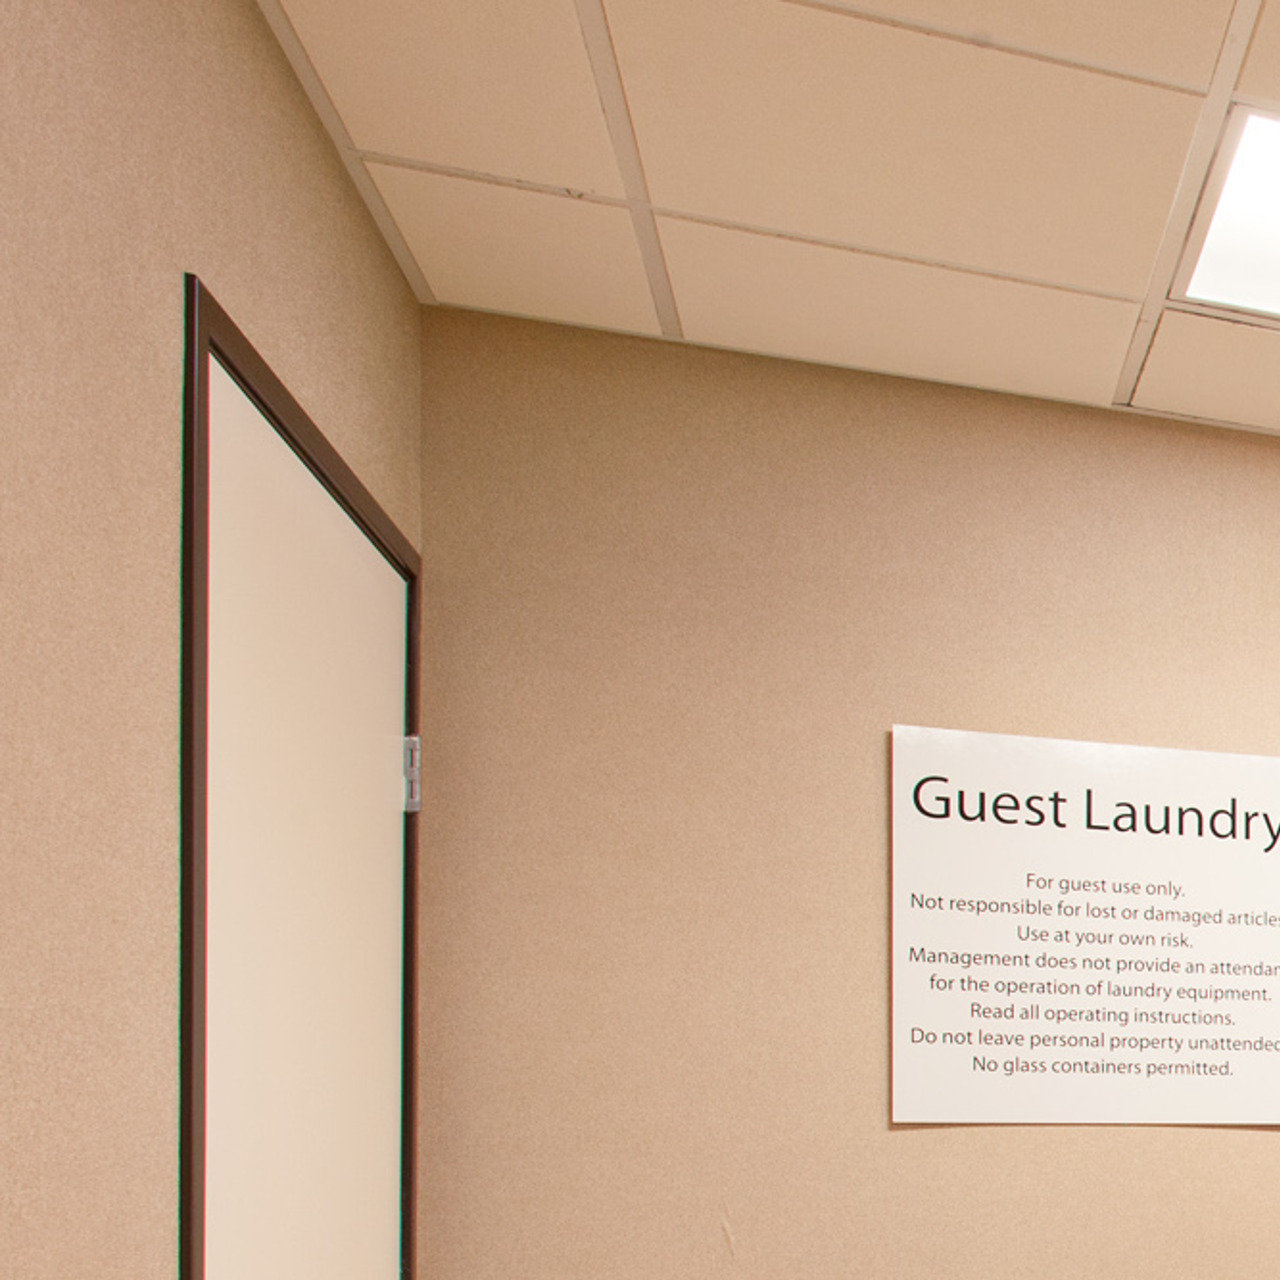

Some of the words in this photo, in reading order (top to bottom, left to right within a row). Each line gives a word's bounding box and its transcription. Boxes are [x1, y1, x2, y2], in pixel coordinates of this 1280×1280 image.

[912, 775, 1068, 828] Guest
[1026, 873, 1054, 890] For
[1059, 878, 1106, 894] guest
[1112, 880, 1140, 893] use
[1145, 880, 1185, 899] only.
[910, 893, 944, 911] Not
[949, 896, 1053, 918] responsible
[1058, 901, 1081, 917] for
[1086, 901, 1116, 919] lost
[1121, 906, 1139, 920] or
[1144, 906, 1222, 926] damaged
[1017, 926, 1049, 942] Use
[1053, 930, 1070, 943] at
[1075, 931, 1114, 949] your
[1119, 933, 1156, 946] own
[1160, 931, 1193, 948] risk.
[908, 947, 1030, 969] Management
[1035, 952, 1078, 969] does
[1083, 956, 1111, 970] not
[1116, 954, 1180, 975] provide
[1185, 959, 1205, 974] an
[930, 974, 954, 991] for
[960, 975, 989, 992] the
[994, 977, 1081, 998] operation
[1085, 980, 1104, 996] of
[1107, 981, 1172, 1001] laundry
[1176, 985, 1272, 1003] equipment.
[970, 1002, 1014, 1020] Read
[1019, 1003, 1040, 1021] all
[1044, 1005, 1129, 1026] operating
[1134, 1008, 1235, 1026] instructions.
[911, 1027, 938, 1044] Do
[943, 1030, 973, 1045] not
[978, 1028, 1025, 1047] leave
[1030, 1031, 1105, 1051] personal
[1109, 1034, 1183, 1052] property
[973, 1055, 998, 1072] No
[1003, 1056, 1047, 1075] glass
[1051, 1057, 1141, 1075] containers
[1146, 1059, 1234, 1077] permitted.
